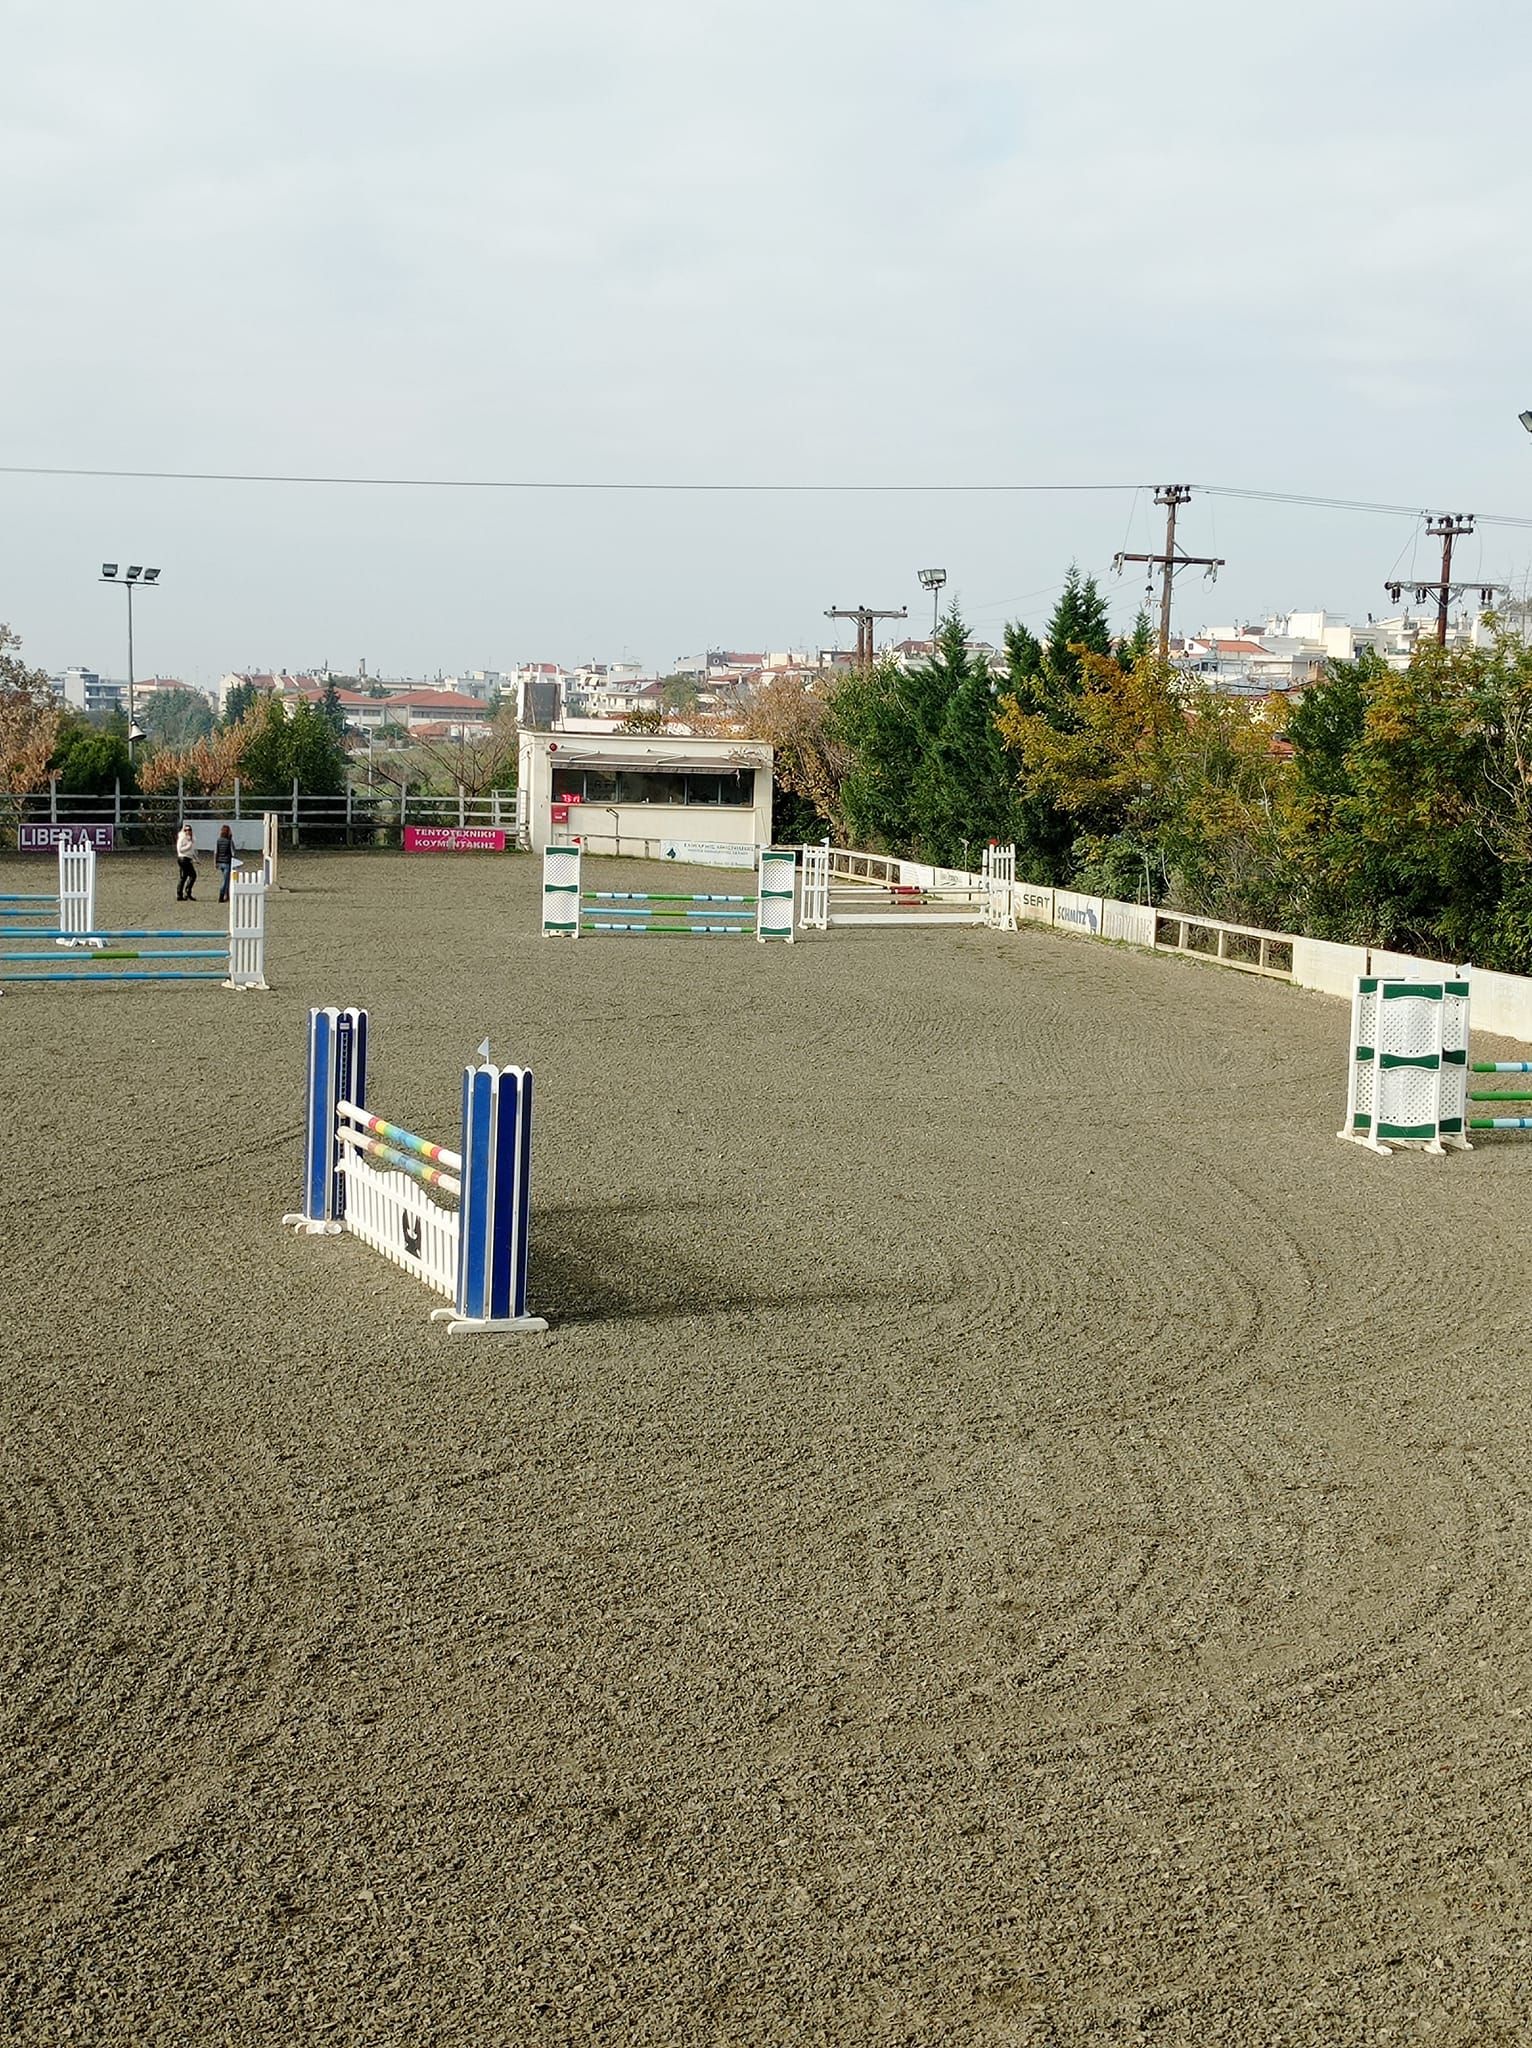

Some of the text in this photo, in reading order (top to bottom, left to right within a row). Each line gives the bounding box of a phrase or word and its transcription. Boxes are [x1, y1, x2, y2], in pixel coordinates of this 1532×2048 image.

[21, 828, 73, 846] LIBER
[414, 828, 496, 838] ΤΕΝΤΟΤΕΧΝΙΚΗ
[1023, 894, 1050, 909] SEAT
[1008, 918, 1013, 928] 6
[1057, 906, 1087, 925] SCHMITZ
